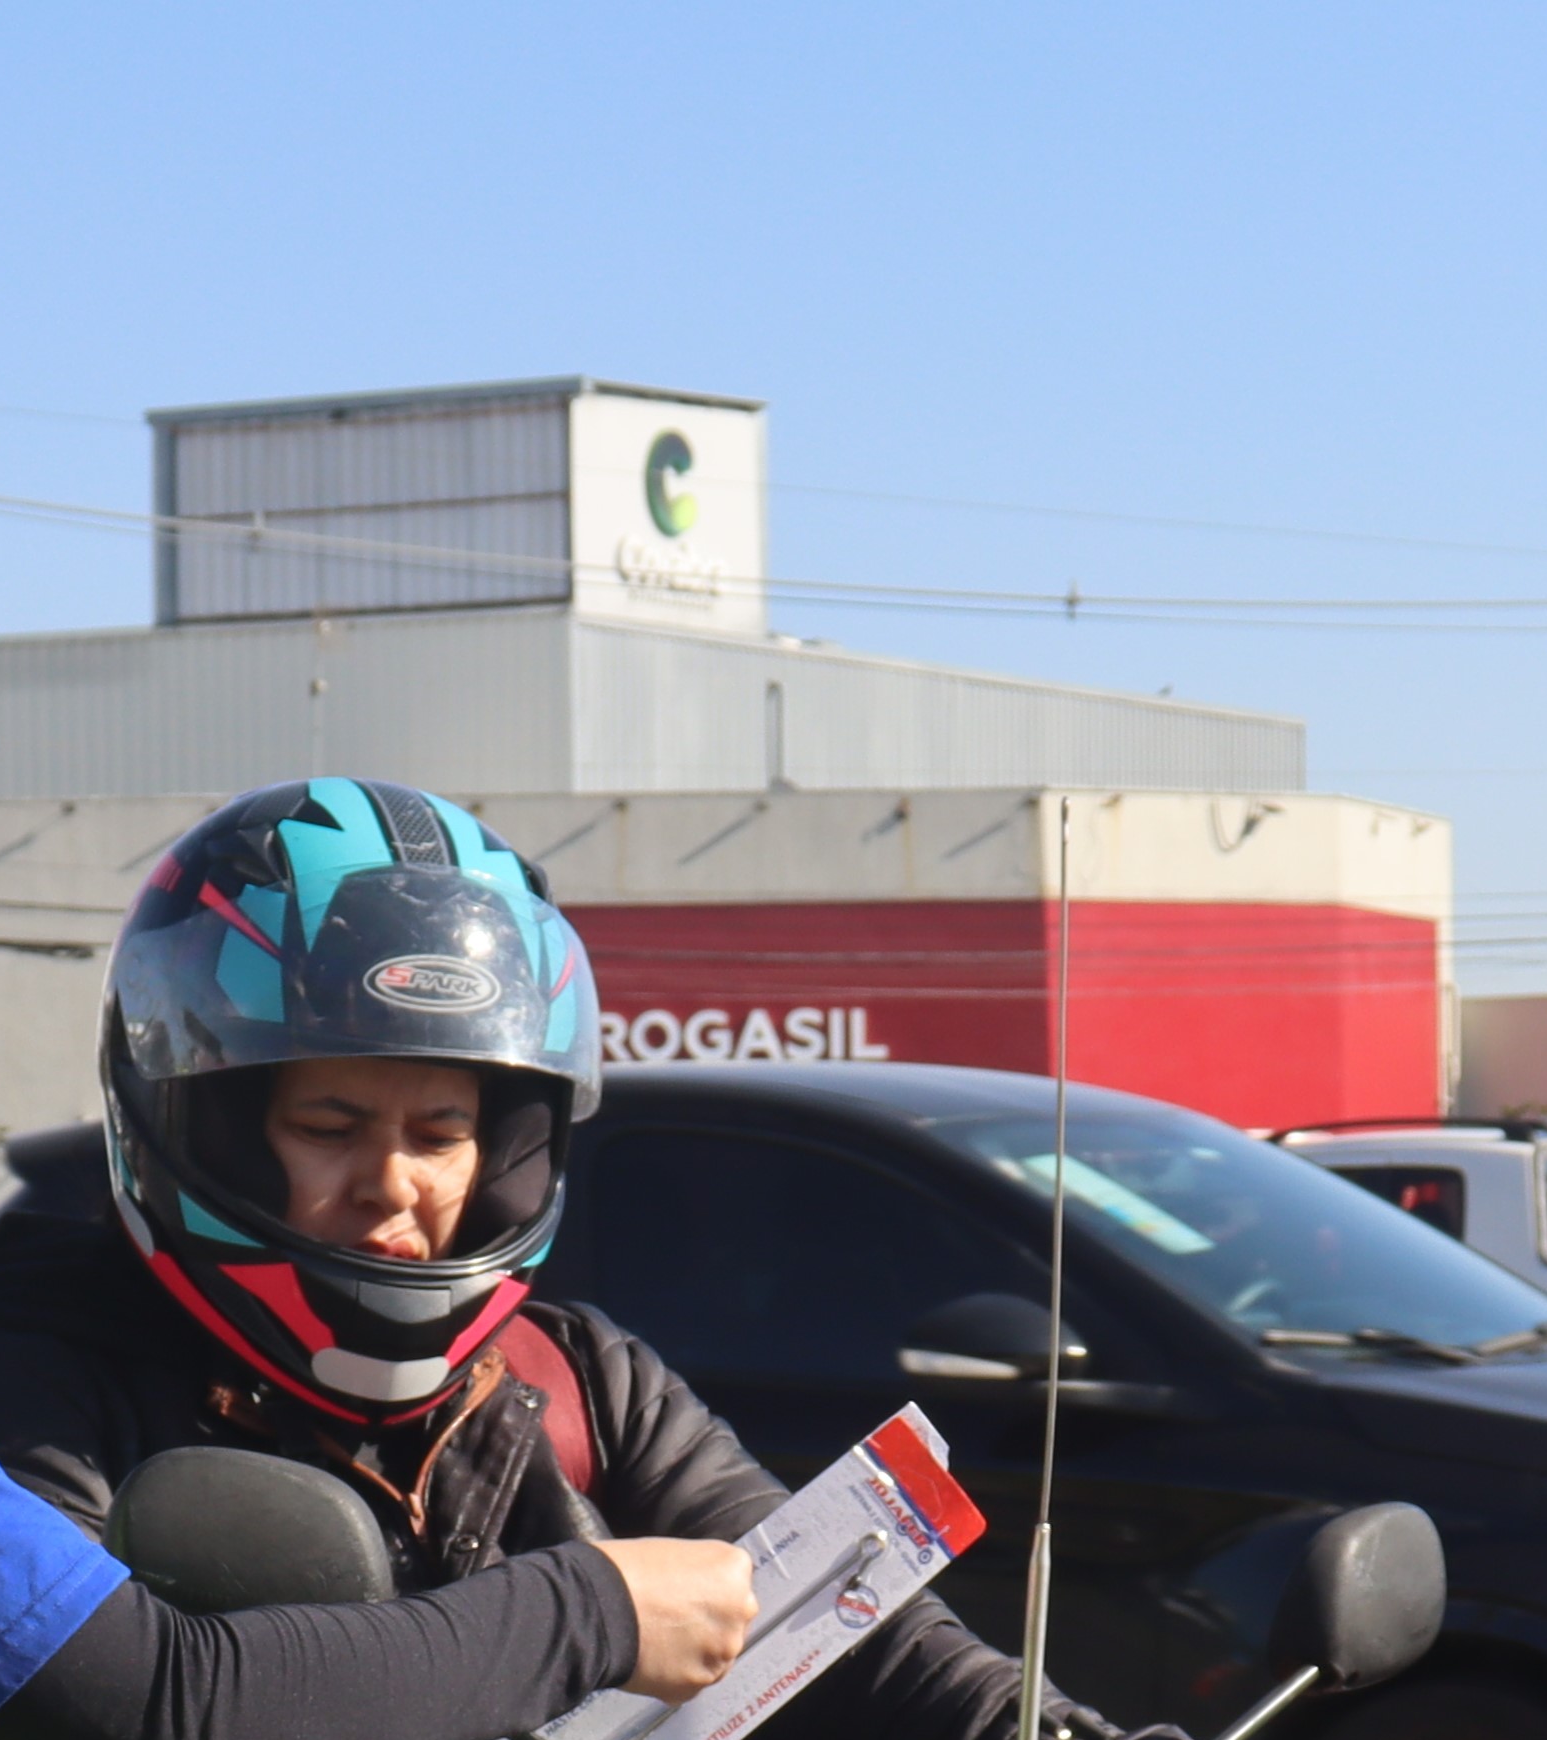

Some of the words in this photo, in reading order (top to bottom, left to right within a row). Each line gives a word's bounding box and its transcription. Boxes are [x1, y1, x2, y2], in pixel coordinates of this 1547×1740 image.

[379, 966, 483, 997] SPARK
[601, 1006, 890, 1061] ROGASIL
[745, 1703, 758, 1716] 2
